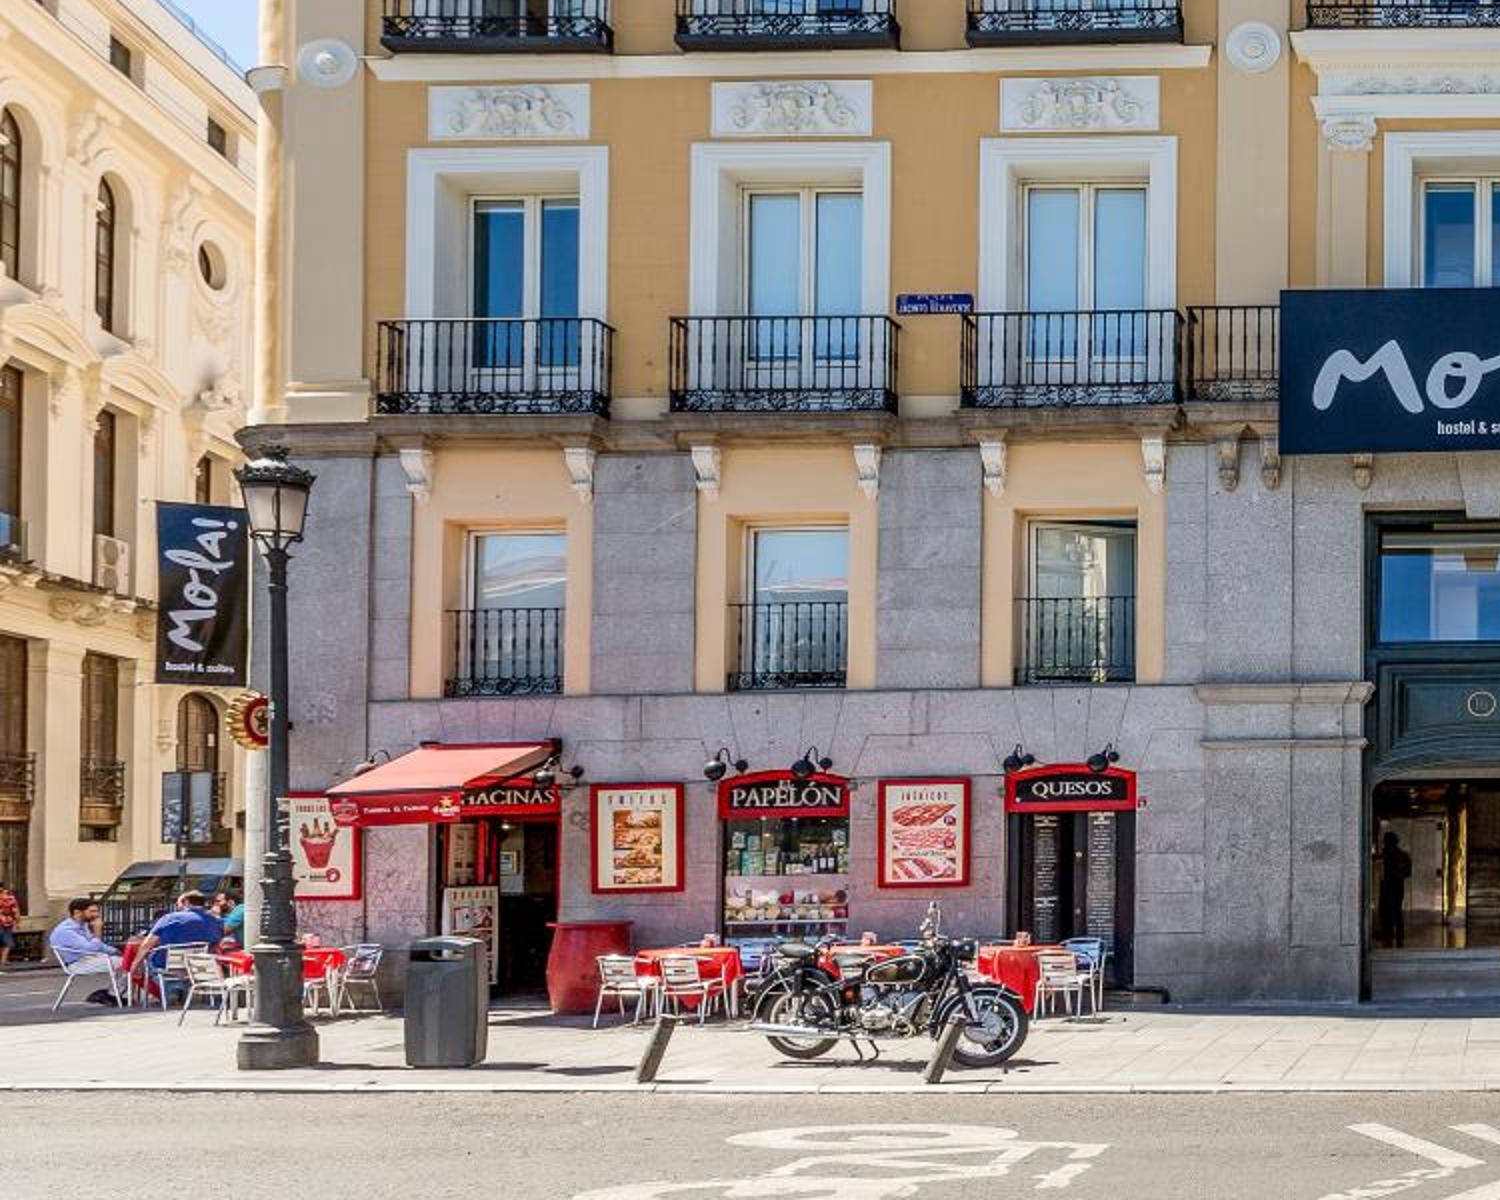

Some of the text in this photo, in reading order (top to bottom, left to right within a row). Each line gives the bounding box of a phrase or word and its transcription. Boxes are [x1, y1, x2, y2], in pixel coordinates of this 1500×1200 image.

[1437, 421, 1476, 435] hostel
[1479, 421, 1488, 434] &
[779, 780, 795, 788] EL
[1031, 781, 1112, 798] QUESOS
[732, 782, 842, 807] PAPELÓN
